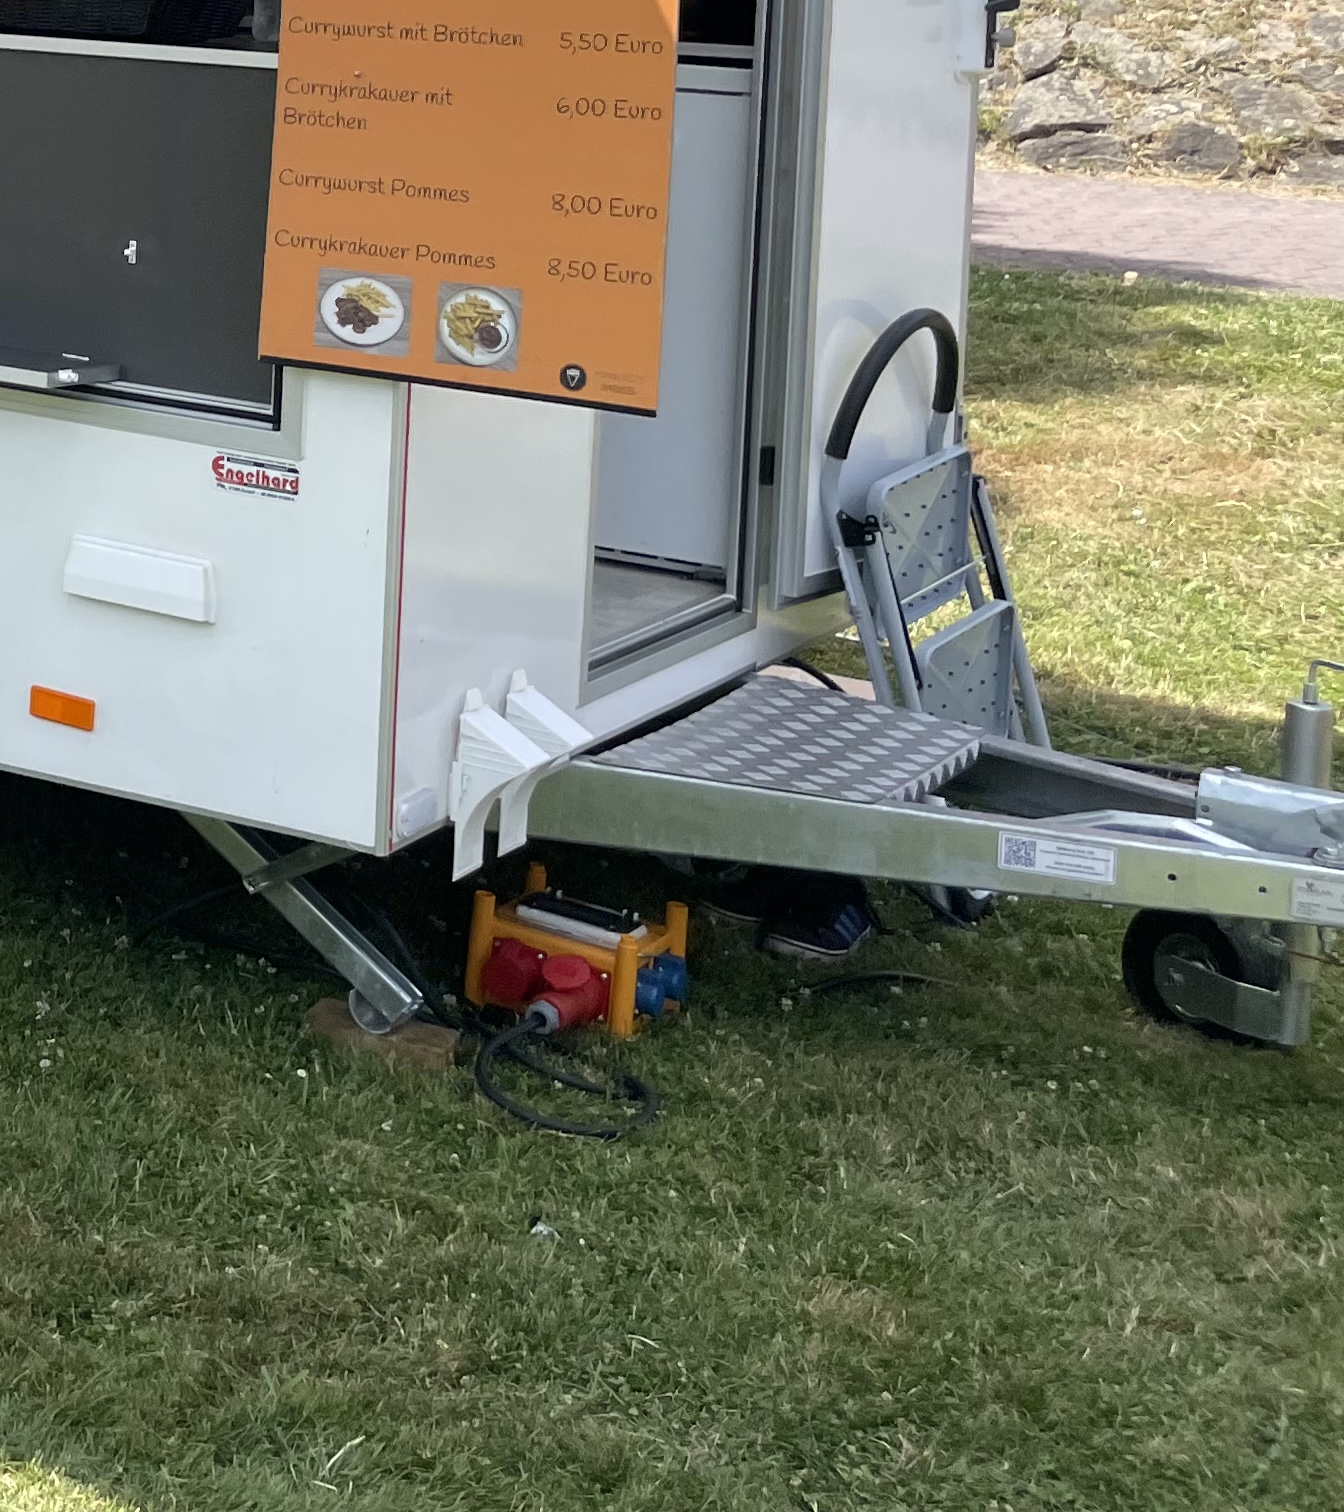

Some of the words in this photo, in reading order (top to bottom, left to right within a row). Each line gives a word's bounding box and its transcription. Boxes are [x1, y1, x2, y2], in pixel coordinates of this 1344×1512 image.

[288, 16, 394, 41] Currywurst
[398, 18, 428, 41] mit
[433, 20, 524, 48] Brötchen
[559, 33, 608, 58] 5,50
[614, 34, 664, 56] Euro
[283, 107, 368, 131] Brötchen
[284, 76, 420, 106] Currykrakauer
[425, 86, 454, 107] mit
[556, 96, 606, 122] 6,00
[614, 98, 662, 122] Euro
[278, 168, 386, 195] Currywurst
[390, 178, 470, 204] Pommes
[551, 192, 602, 218] 8,00
[609, 196, 658, 220] Euro
[274, 228, 410, 261] Currykrakauer
[414, 244, 496, 270] Pommes
[547, 258, 597, 282] 8,50
[603, 262, 653, 286] Euro
[211, 455, 300, 493] Engelhard
